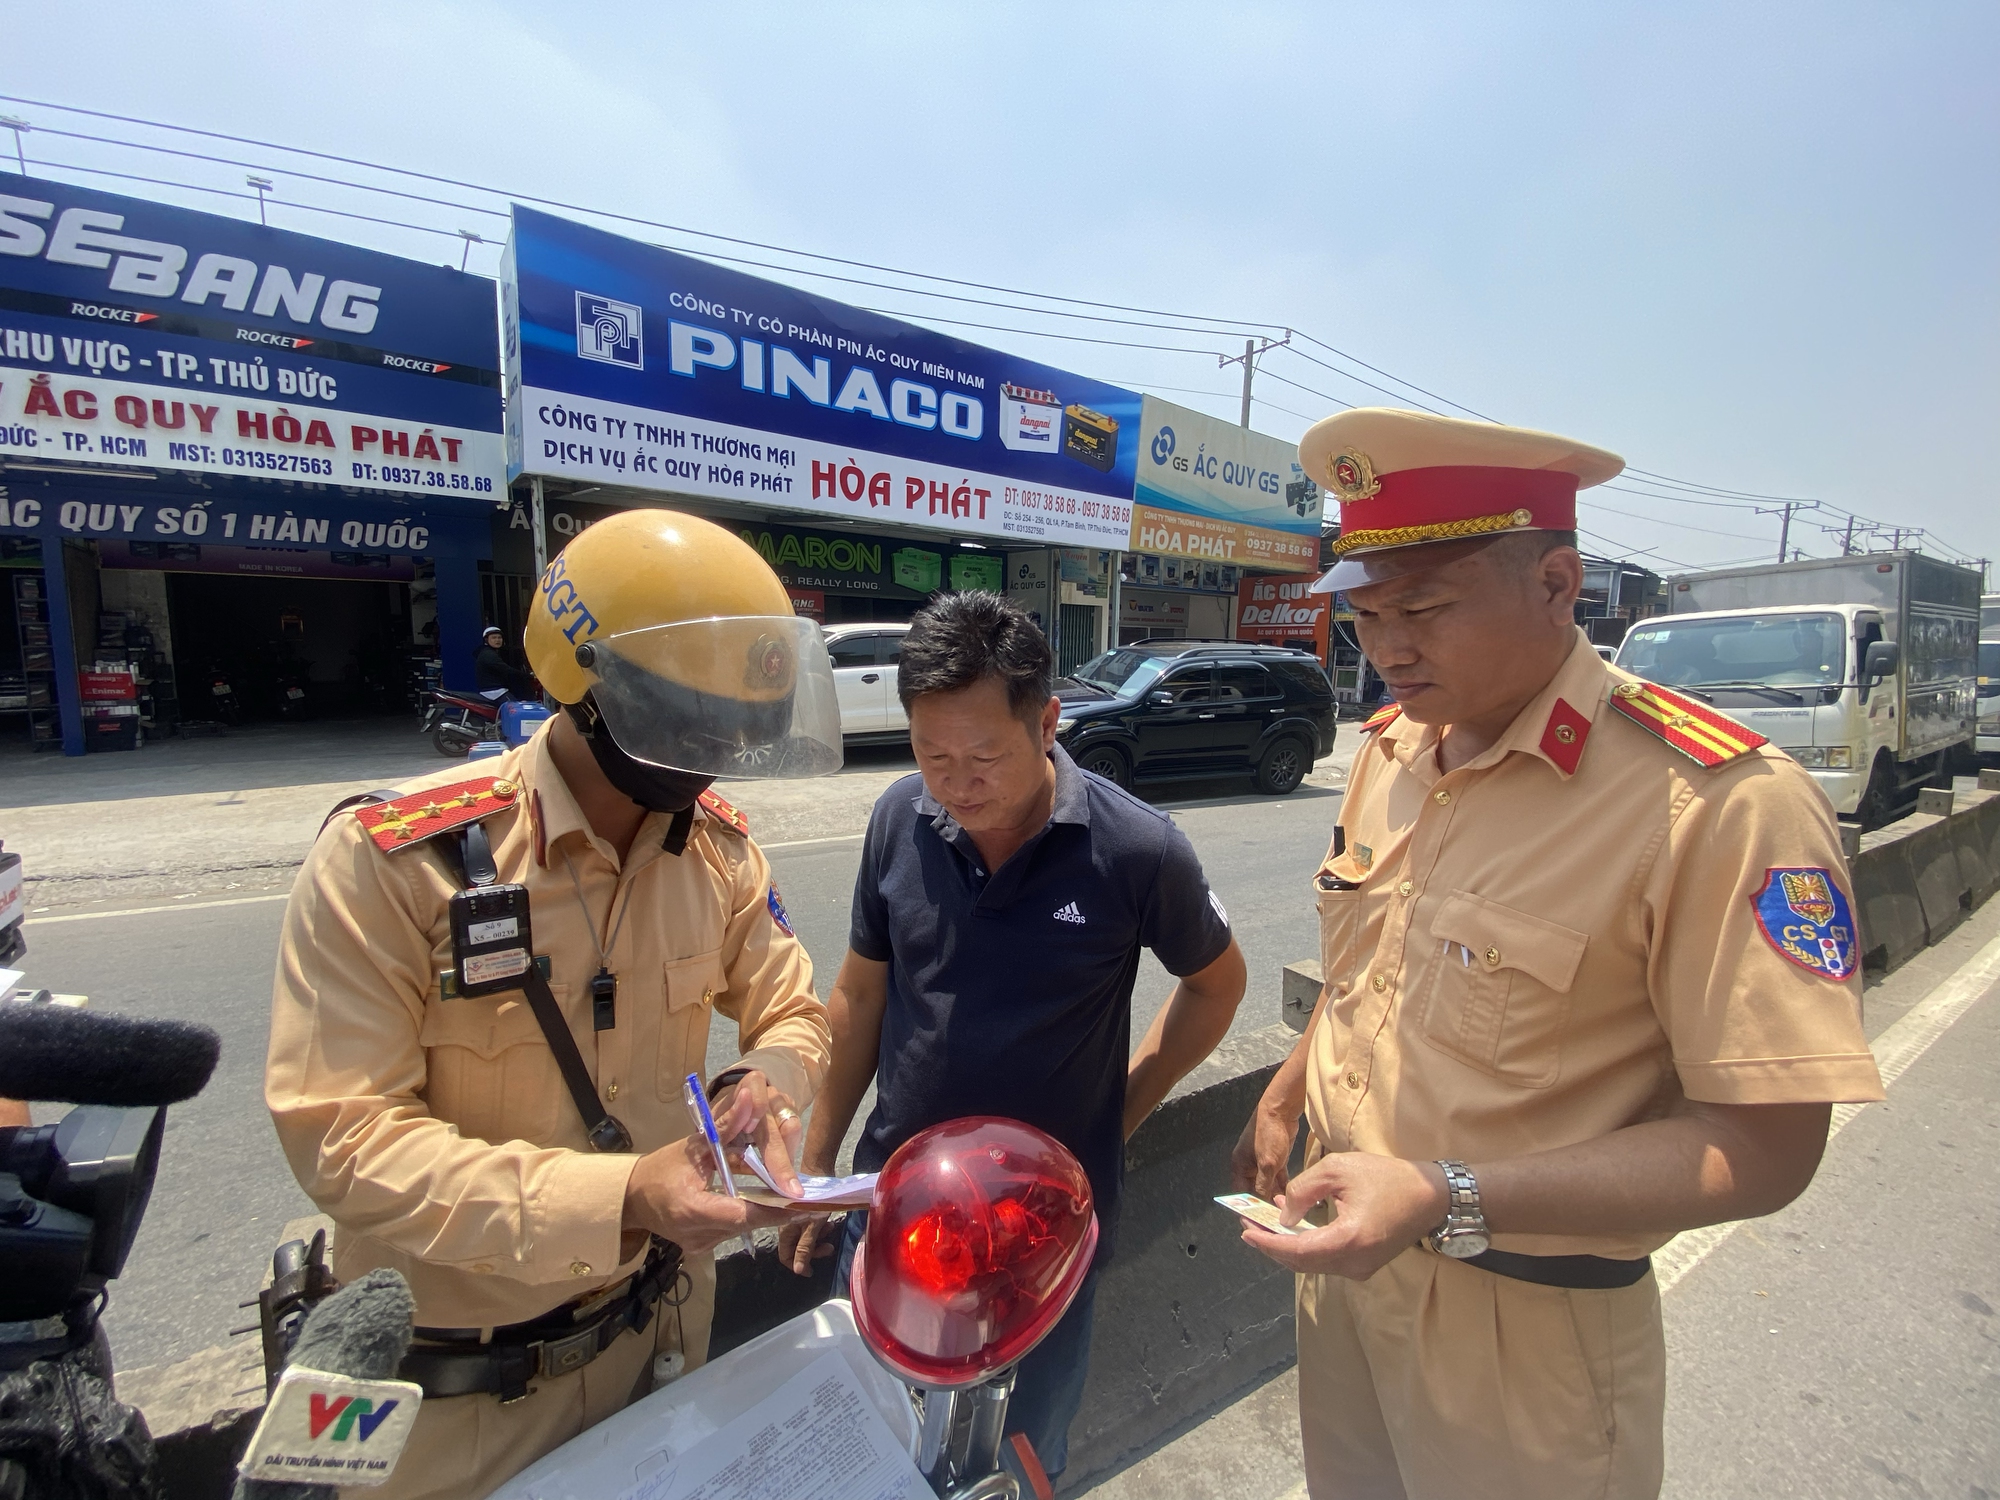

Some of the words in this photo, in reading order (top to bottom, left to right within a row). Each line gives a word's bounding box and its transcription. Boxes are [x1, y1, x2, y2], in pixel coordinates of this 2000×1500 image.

[0, 194, 382, 334] SEBANG
[71, 303, 145, 324] ROCKET
[236, 328, 302, 349] ROCKET
[669, 292, 726, 319] CÔNG
[730, 308, 753, 326] TY
[837, 337, 862, 356] PIN
[890, 353, 920, 371] QUY
[957, 371, 985, 390] NAM
[62, 337, 131, 376] VỰC
[140, 358, 152, 367] -
[157, 350, 203, 382] TP.
[209, 357, 270, 392] THỦ
[278, 367, 337, 401] ĐỨC
[383, 354, 441, 373] ROCKET
[667, 317, 985, 442] PINACO
[24, 374, 99, 420] ẮC
[114, 396, 220, 434] QUY
[236, 408, 336, 448] HÒA
[351, 425, 463, 463] PHÁT
[538, 404, 597, 432] CÔNG
[602, 416, 627, 439] TY
[633, 422, 686, 448] TNHH
[691, 432, 762, 461] THƯƠNG
[766, 446, 795, 469] MẠI
[62, 432, 93, 453] TP.
[101, 435, 147, 457] HCM
[169, 442, 216, 464] MST:
[223, 449, 332, 476] 0313527563
[352, 462, 378, 481] ĐT:
[382, 467, 492, 493] 0937.38.58.68
[543, 439, 593, 464] DỊCH
[599, 447, 626, 473] VỤ
[633, 447, 658, 474] ẮC
[664, 458, 701, 481] QUY
[708, 464, 744, 488] HÒA
[750, 473, 793, 493] PHÁT
[1172, 456, 1189, 472] GS
[1193, 443, 1218, 480] ẮC
[1222, 460, 1256, 489] QUY
[1258, 471, 1280, 495] GS
[811, 457, 892, 508] HÒA
[905, 476, 991, 520] PHÁT
[1004, 487, 1019, 506] ĐT:
[1021, 490, 1041, 509] 0837
[1043, 494, 1053, 511] 38
[1055, 495, 1065, 513] 58
[1066, 498, 1076, 515] 68
[1082, 501, 1100, 518] 0937
[1101, 504, 1110, 520] 38
[1112, 506, 1121, 521] 58
[1122, 507, 1131, 523] 68
[60, 501, 144, 532] QUY
[155, 501, 213, 536] SỐ
[221, 513, 237, 538] 1
[250, 511, 329, 544] HÀN
[341, 518, 429, 550] QUỐC
[1022, 513, 1032, 522] 254
[740, 530, 882, 574] MARON
[1140, 524, 1182, 552] HÒA
[1187, 534, 1236, 559] PHÁT
[1247, 538, 1272, 551] 0937
[1274, 542, 1286, 553] 38
[1288, 544, 1300, 556] 58
[1301, 547, 1313, 558] 68
[542, 552, 600, 646] SGT
[797, 576, 841, 588] REALLY
[846, 580, 881, 590] LONG.
[1020, 581, 1034, 590] QUY
[1036, 581, 1046, 589] GS
[1252, 579, 1276, 601] ẮC
[1279, 582, 1313, 601] QUY
[792, 598, 815, 608] ANG
[1240, 603, 1325, 625] Delkor
[493, 929, 515, 939] 00239
[1053, 909, 1086, 925] adidas
[1783, 924, 1818, 941] CS
[309, 1393, 400, 1442] VTV
[366, 1460, 388, 1470] NAM
